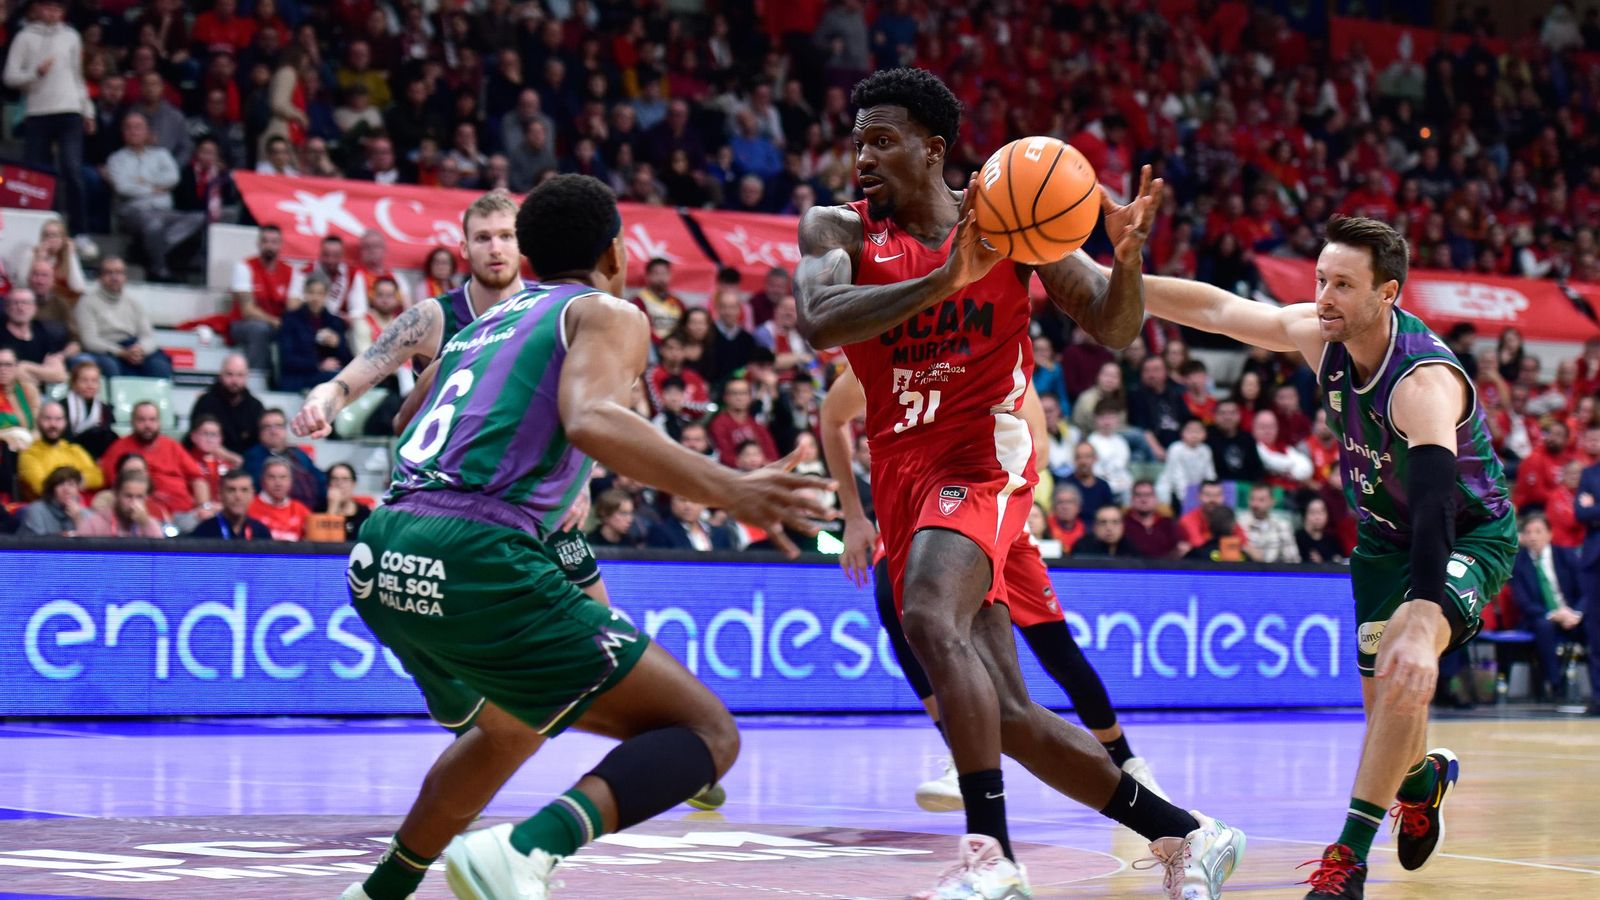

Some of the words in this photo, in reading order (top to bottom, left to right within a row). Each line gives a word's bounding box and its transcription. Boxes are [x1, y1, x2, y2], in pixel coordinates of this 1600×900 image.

[399, 369, 474, 464] 6
[893, 390, 941, 433] 31
[378, 572, 403, 593] DEL
[405, 578, 444, 599] SOL
[380, 550, 447, 580] COSTA
[640, 591, 905, 679] ndes
[0, 831, 834, 870] UCM
